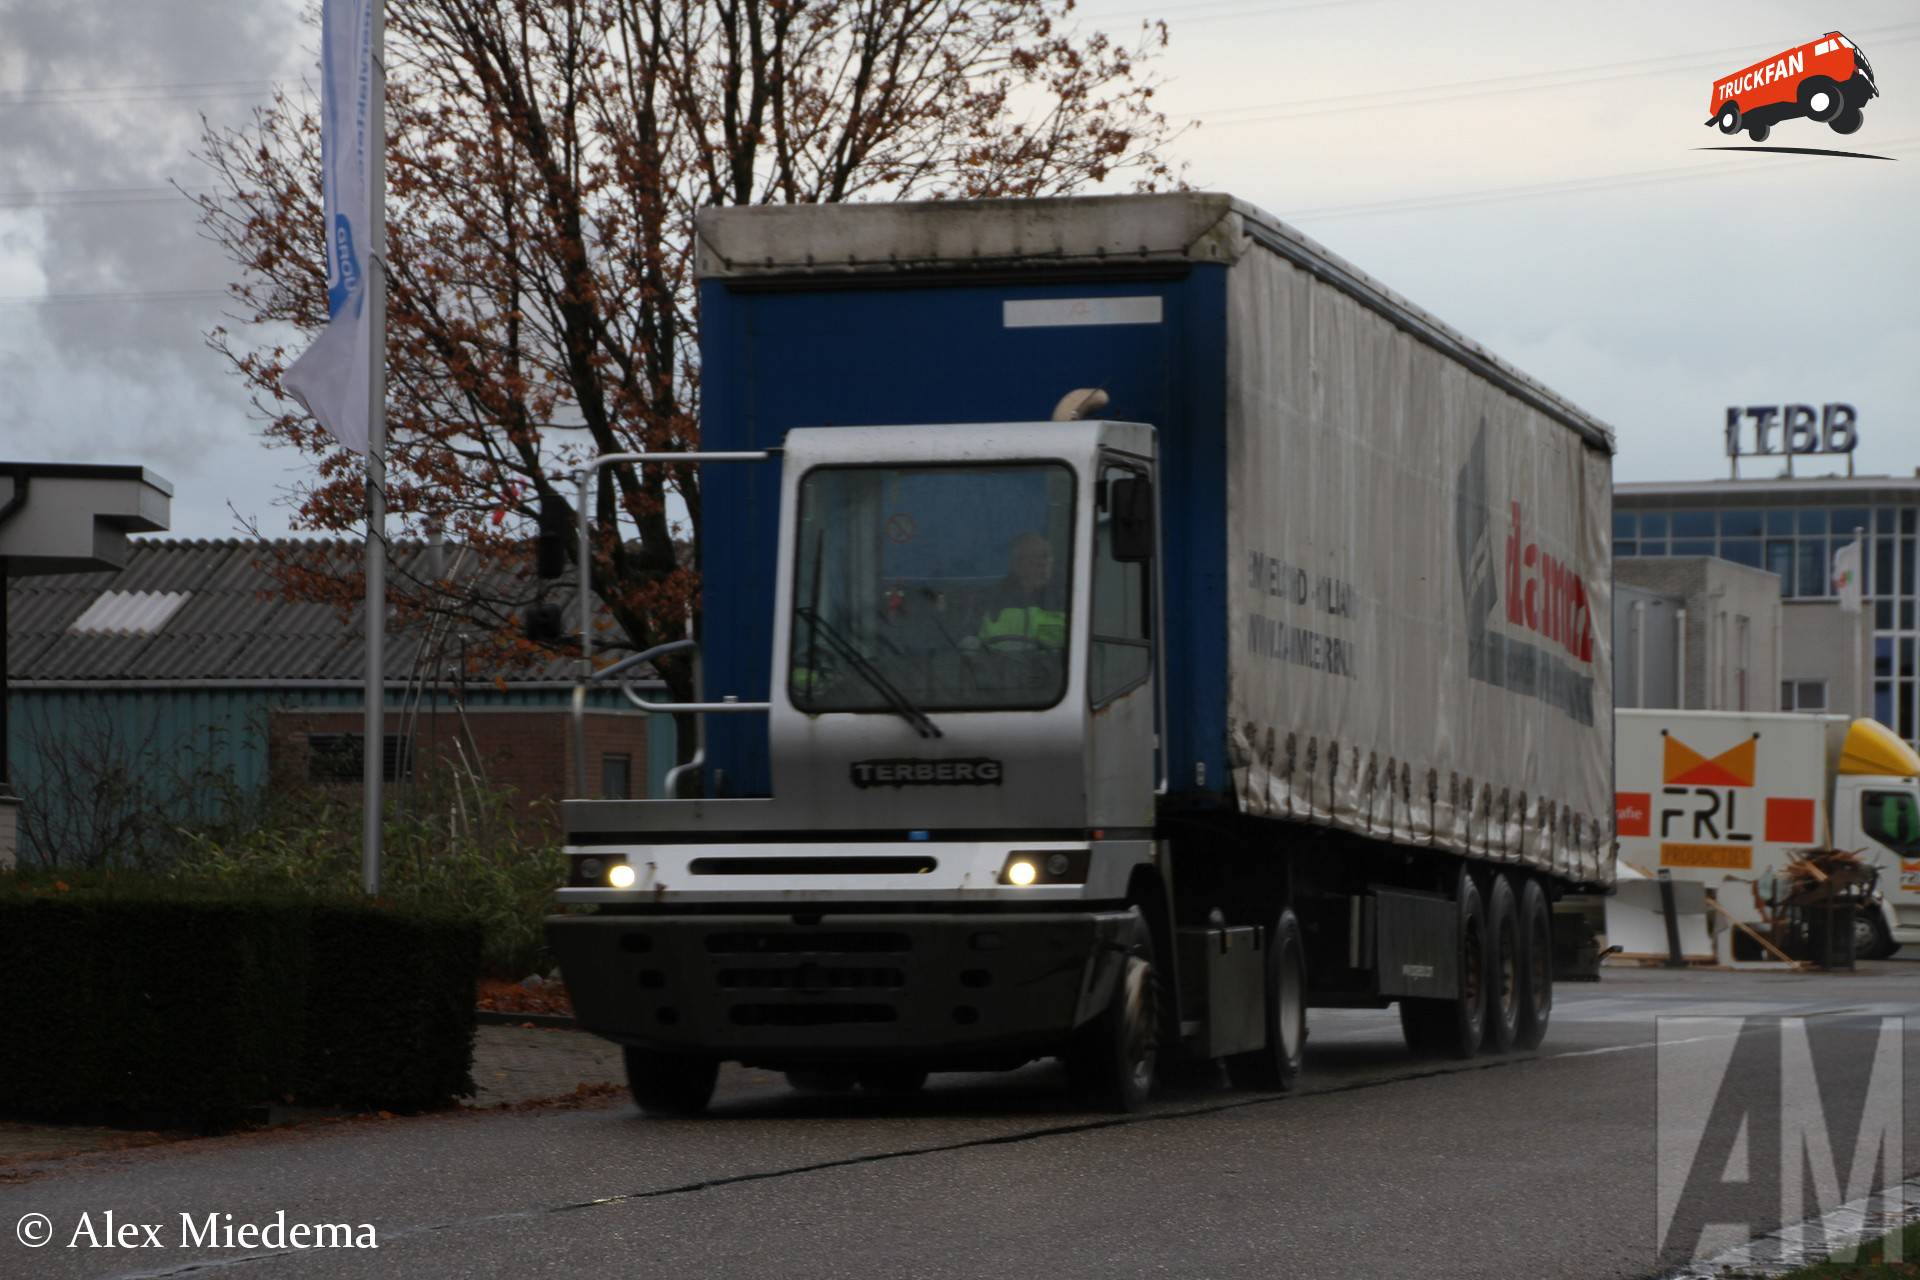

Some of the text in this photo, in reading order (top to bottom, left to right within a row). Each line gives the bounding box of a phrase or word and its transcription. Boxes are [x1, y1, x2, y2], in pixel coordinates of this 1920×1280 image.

[336, 225, 358, 296] GROU
[855, 762, 1000, 781] TERBERG
[1661, 787, 1753, 840] FRL
